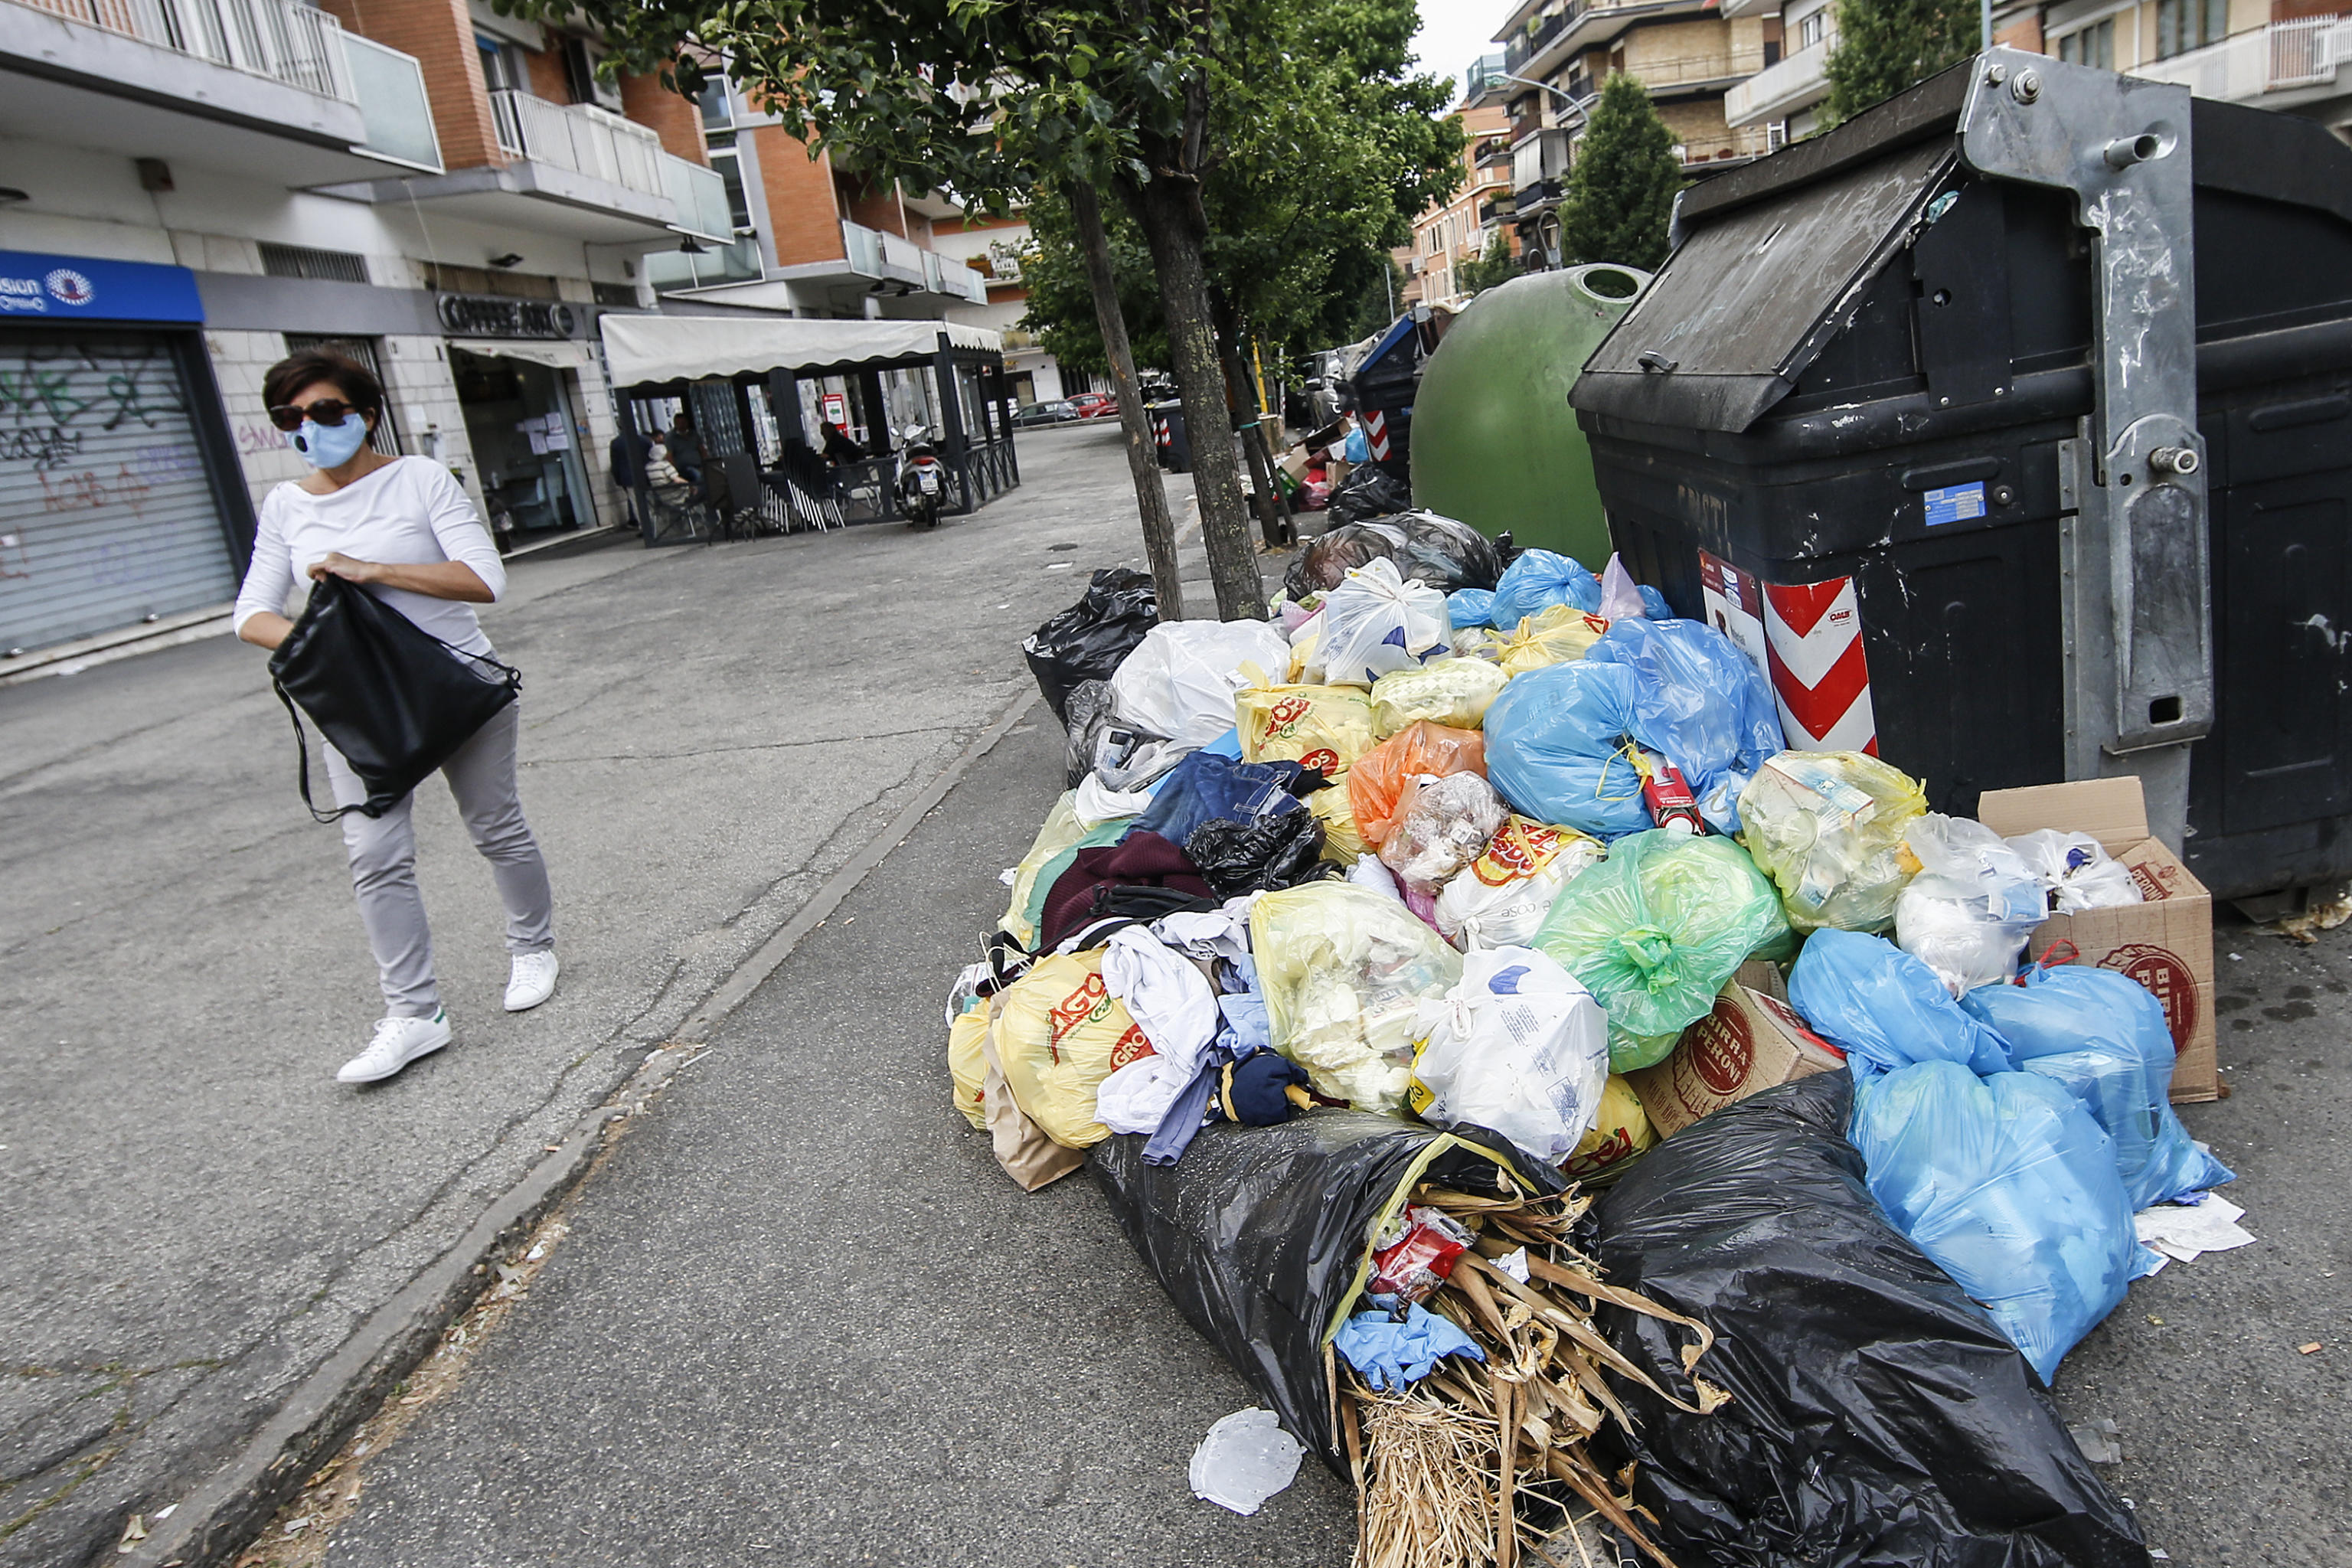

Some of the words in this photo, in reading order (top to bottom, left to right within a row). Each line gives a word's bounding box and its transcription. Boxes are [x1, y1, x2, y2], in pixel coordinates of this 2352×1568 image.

[1112, 1031, 1146, 1067] GRO
[1697, 1025, 1742, 1083] PERONI
[1706, 1012, 1748, 1066] BIRRA
